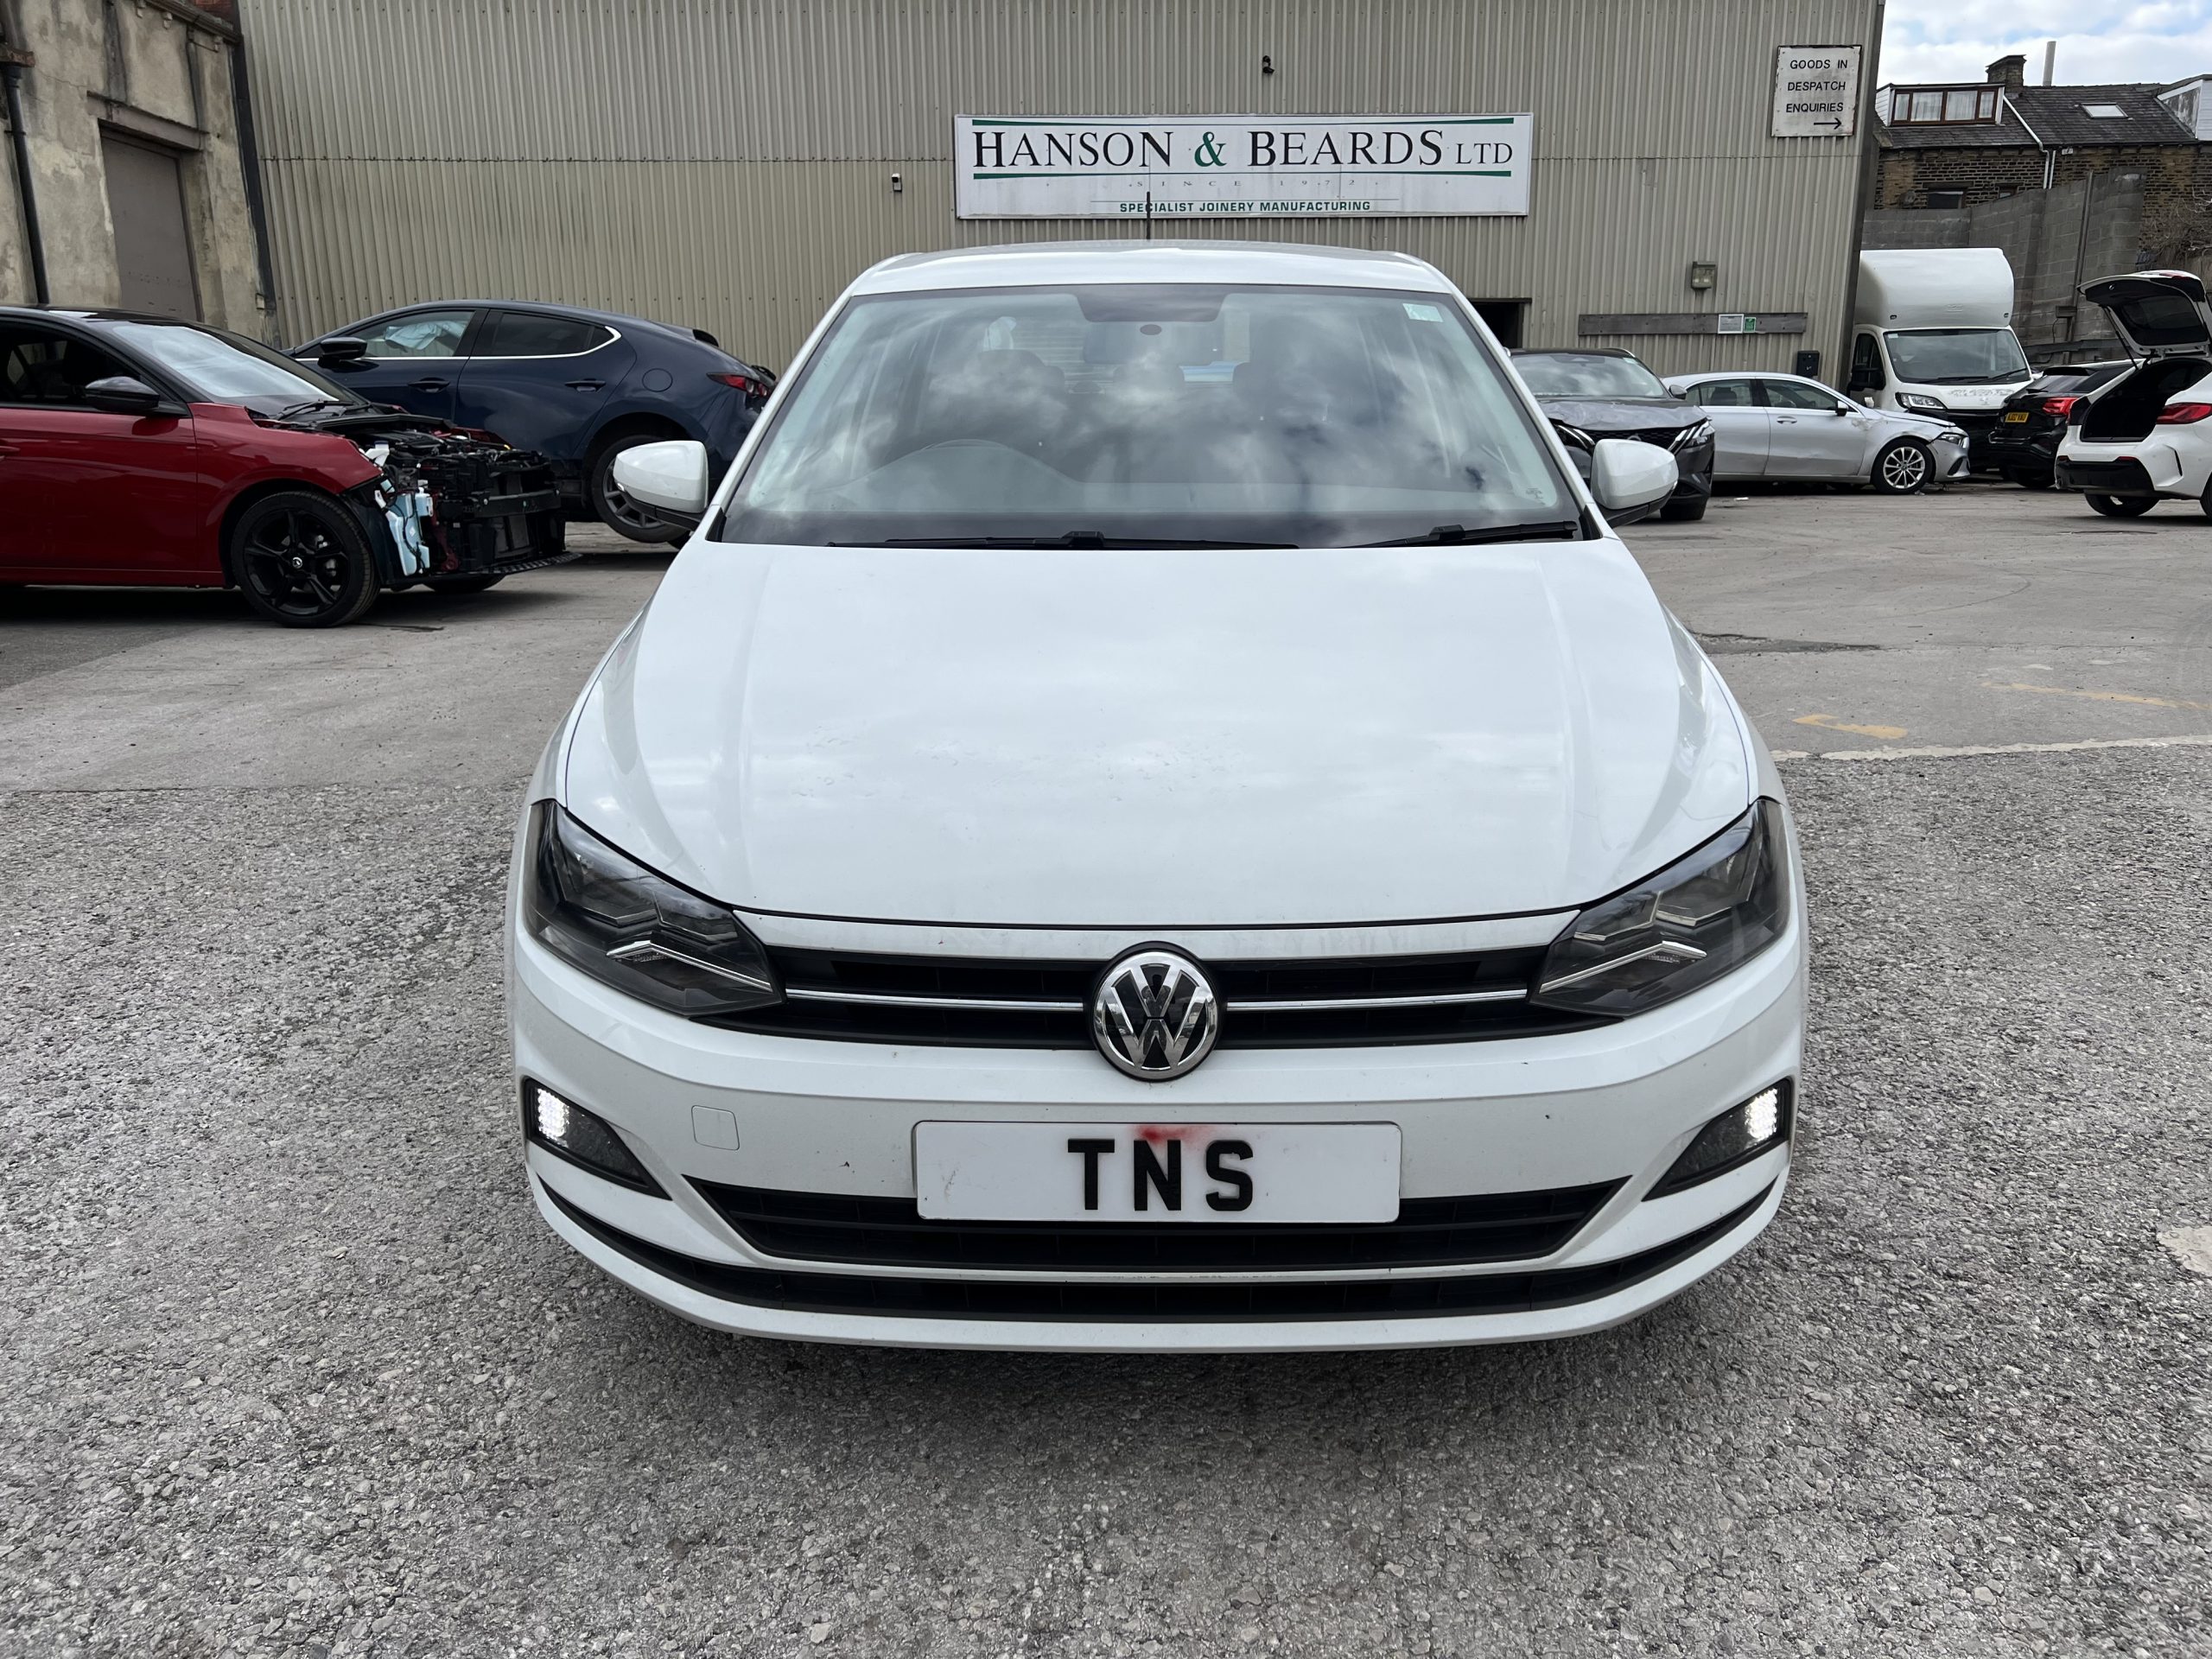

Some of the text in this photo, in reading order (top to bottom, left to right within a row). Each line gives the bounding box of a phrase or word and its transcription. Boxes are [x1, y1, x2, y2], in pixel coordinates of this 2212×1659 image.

[1789, 60, 1848, 69] GOODS IN
[1787, 81, 1847, 91] DESPATCH
[1785, 102, 1844, 112] ENQUIRIES
[971, 130, 1513, 168] HANSON & BEARDS LTD
[1199, 201, 1254, 213] JOINERY
[1260, 200, 1370, 212] MANUFACTURING
[1067, 1138, 1254, 1212] TNS
